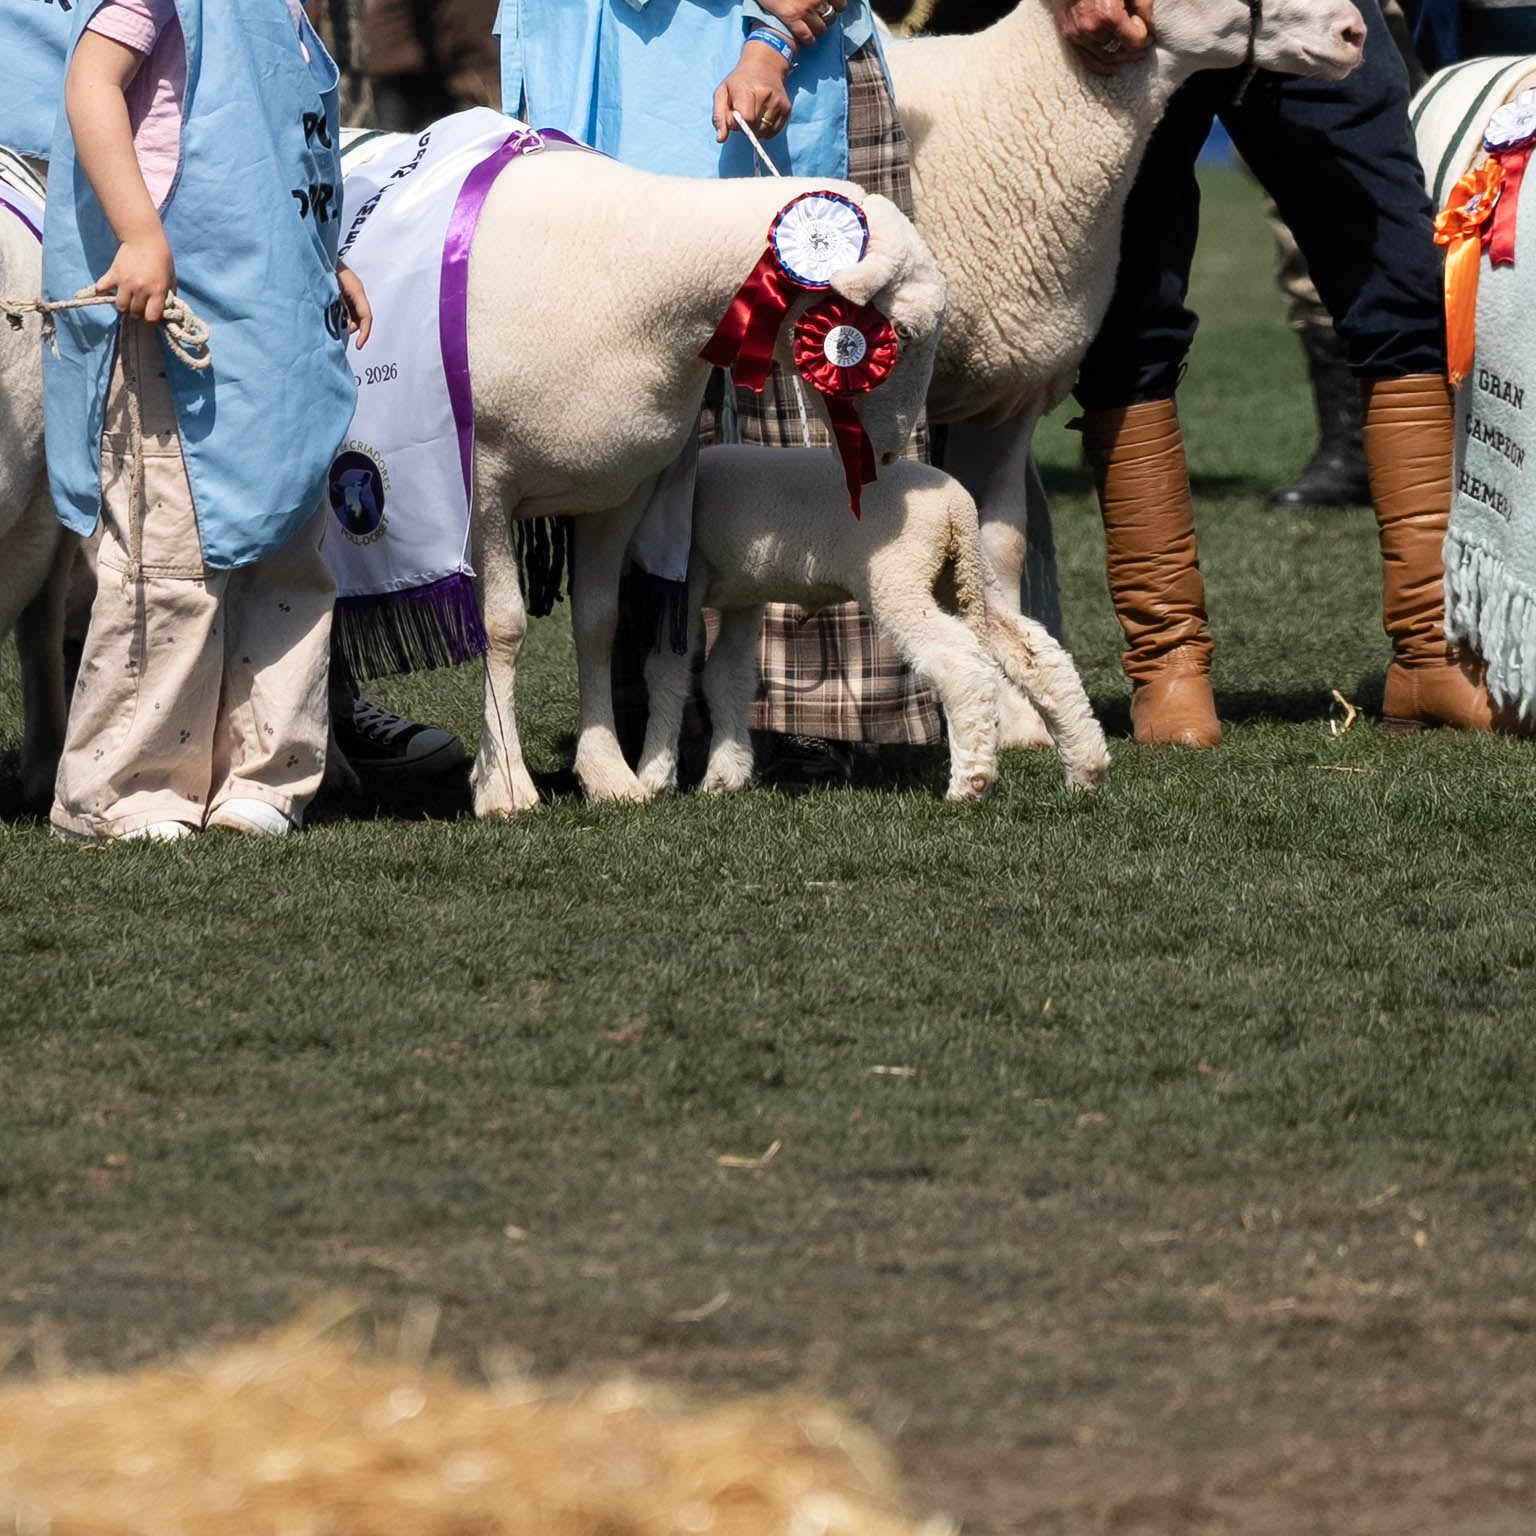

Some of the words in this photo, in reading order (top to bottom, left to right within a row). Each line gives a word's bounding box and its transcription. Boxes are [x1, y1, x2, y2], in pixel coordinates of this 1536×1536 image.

[389, 131, 431, 179] GRAN
[365, 362, 399, 385] 2026
[1479, 369, 1525, 409] GRAN
[350, 439, 392, 491] CRIADORES
[1465, 414, 1525, 470] CAMPEON
